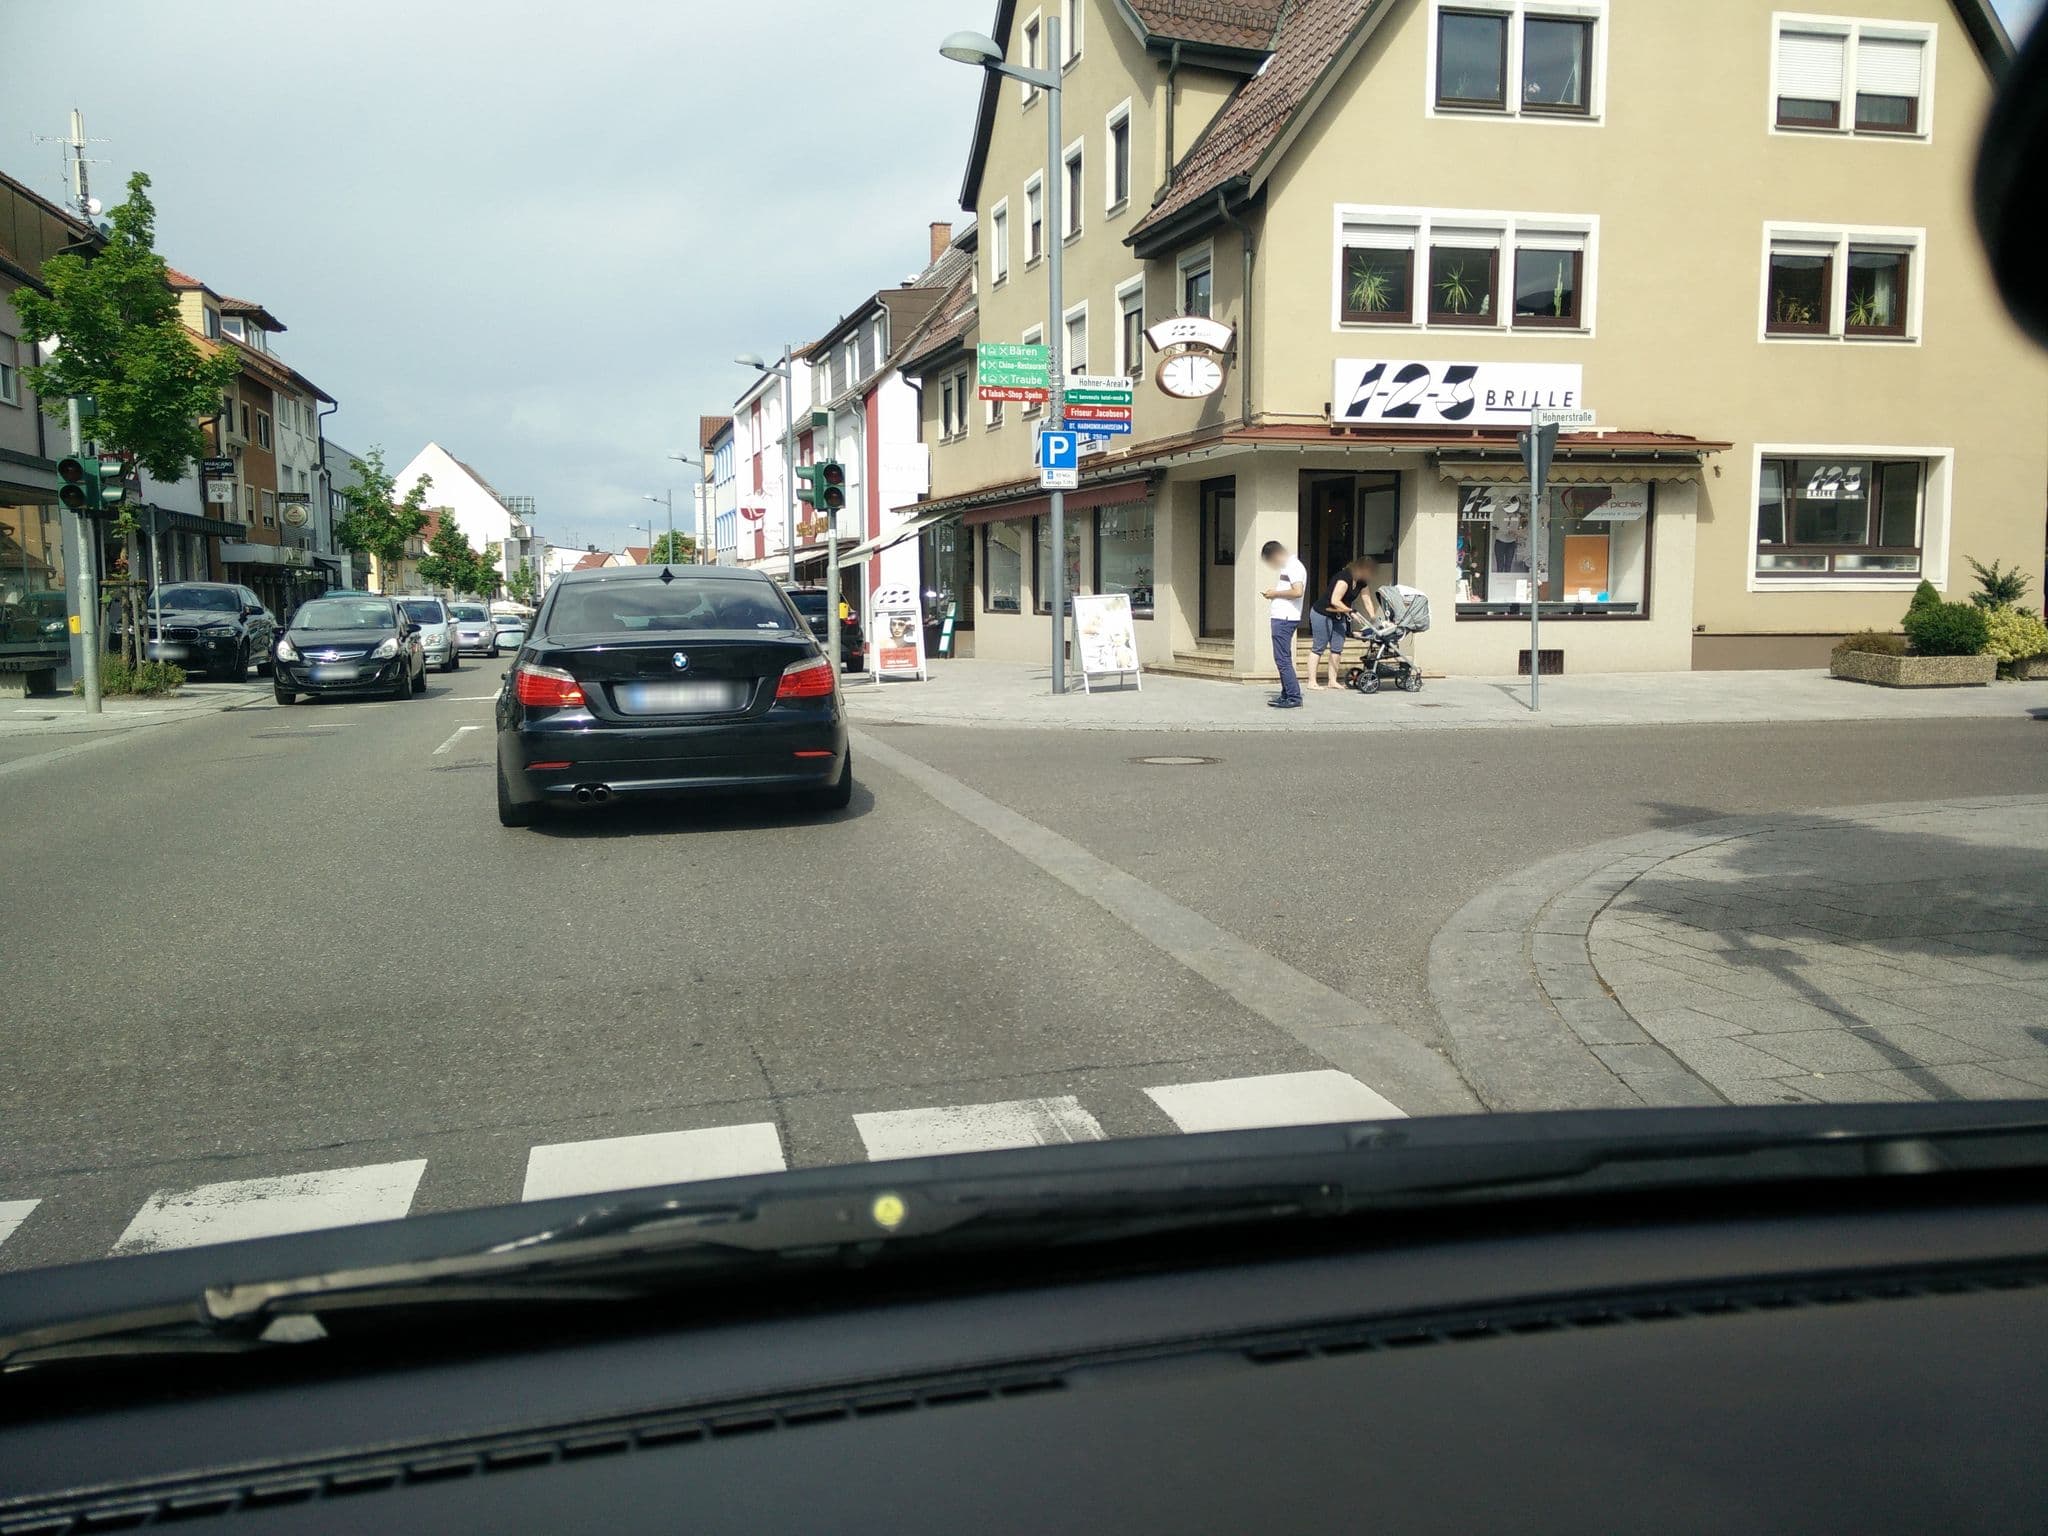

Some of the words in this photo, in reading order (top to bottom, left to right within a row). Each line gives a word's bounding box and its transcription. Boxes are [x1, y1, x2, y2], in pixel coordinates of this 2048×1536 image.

[1009, 345, 1038, 356] Bären
[1010, 374, 1042, 385] Traube
[1079, 378, 1124, 388] Hohner-Areal
[988, 389, 1023, 400] Tabak-Shop
[1345, 363, 1479, 421] 1-2-3
[1485, 390, 1574, 408] BRILLE
[1070, 407, 1093, 417] Friseur
[1095, 408, 1124, 418] Jacobsen
[1542, 411, 1593, 422] Hohnerstraße
[1049, 436, 1069, 465] P
[1806, 489, 1837, 498] BRILLE
